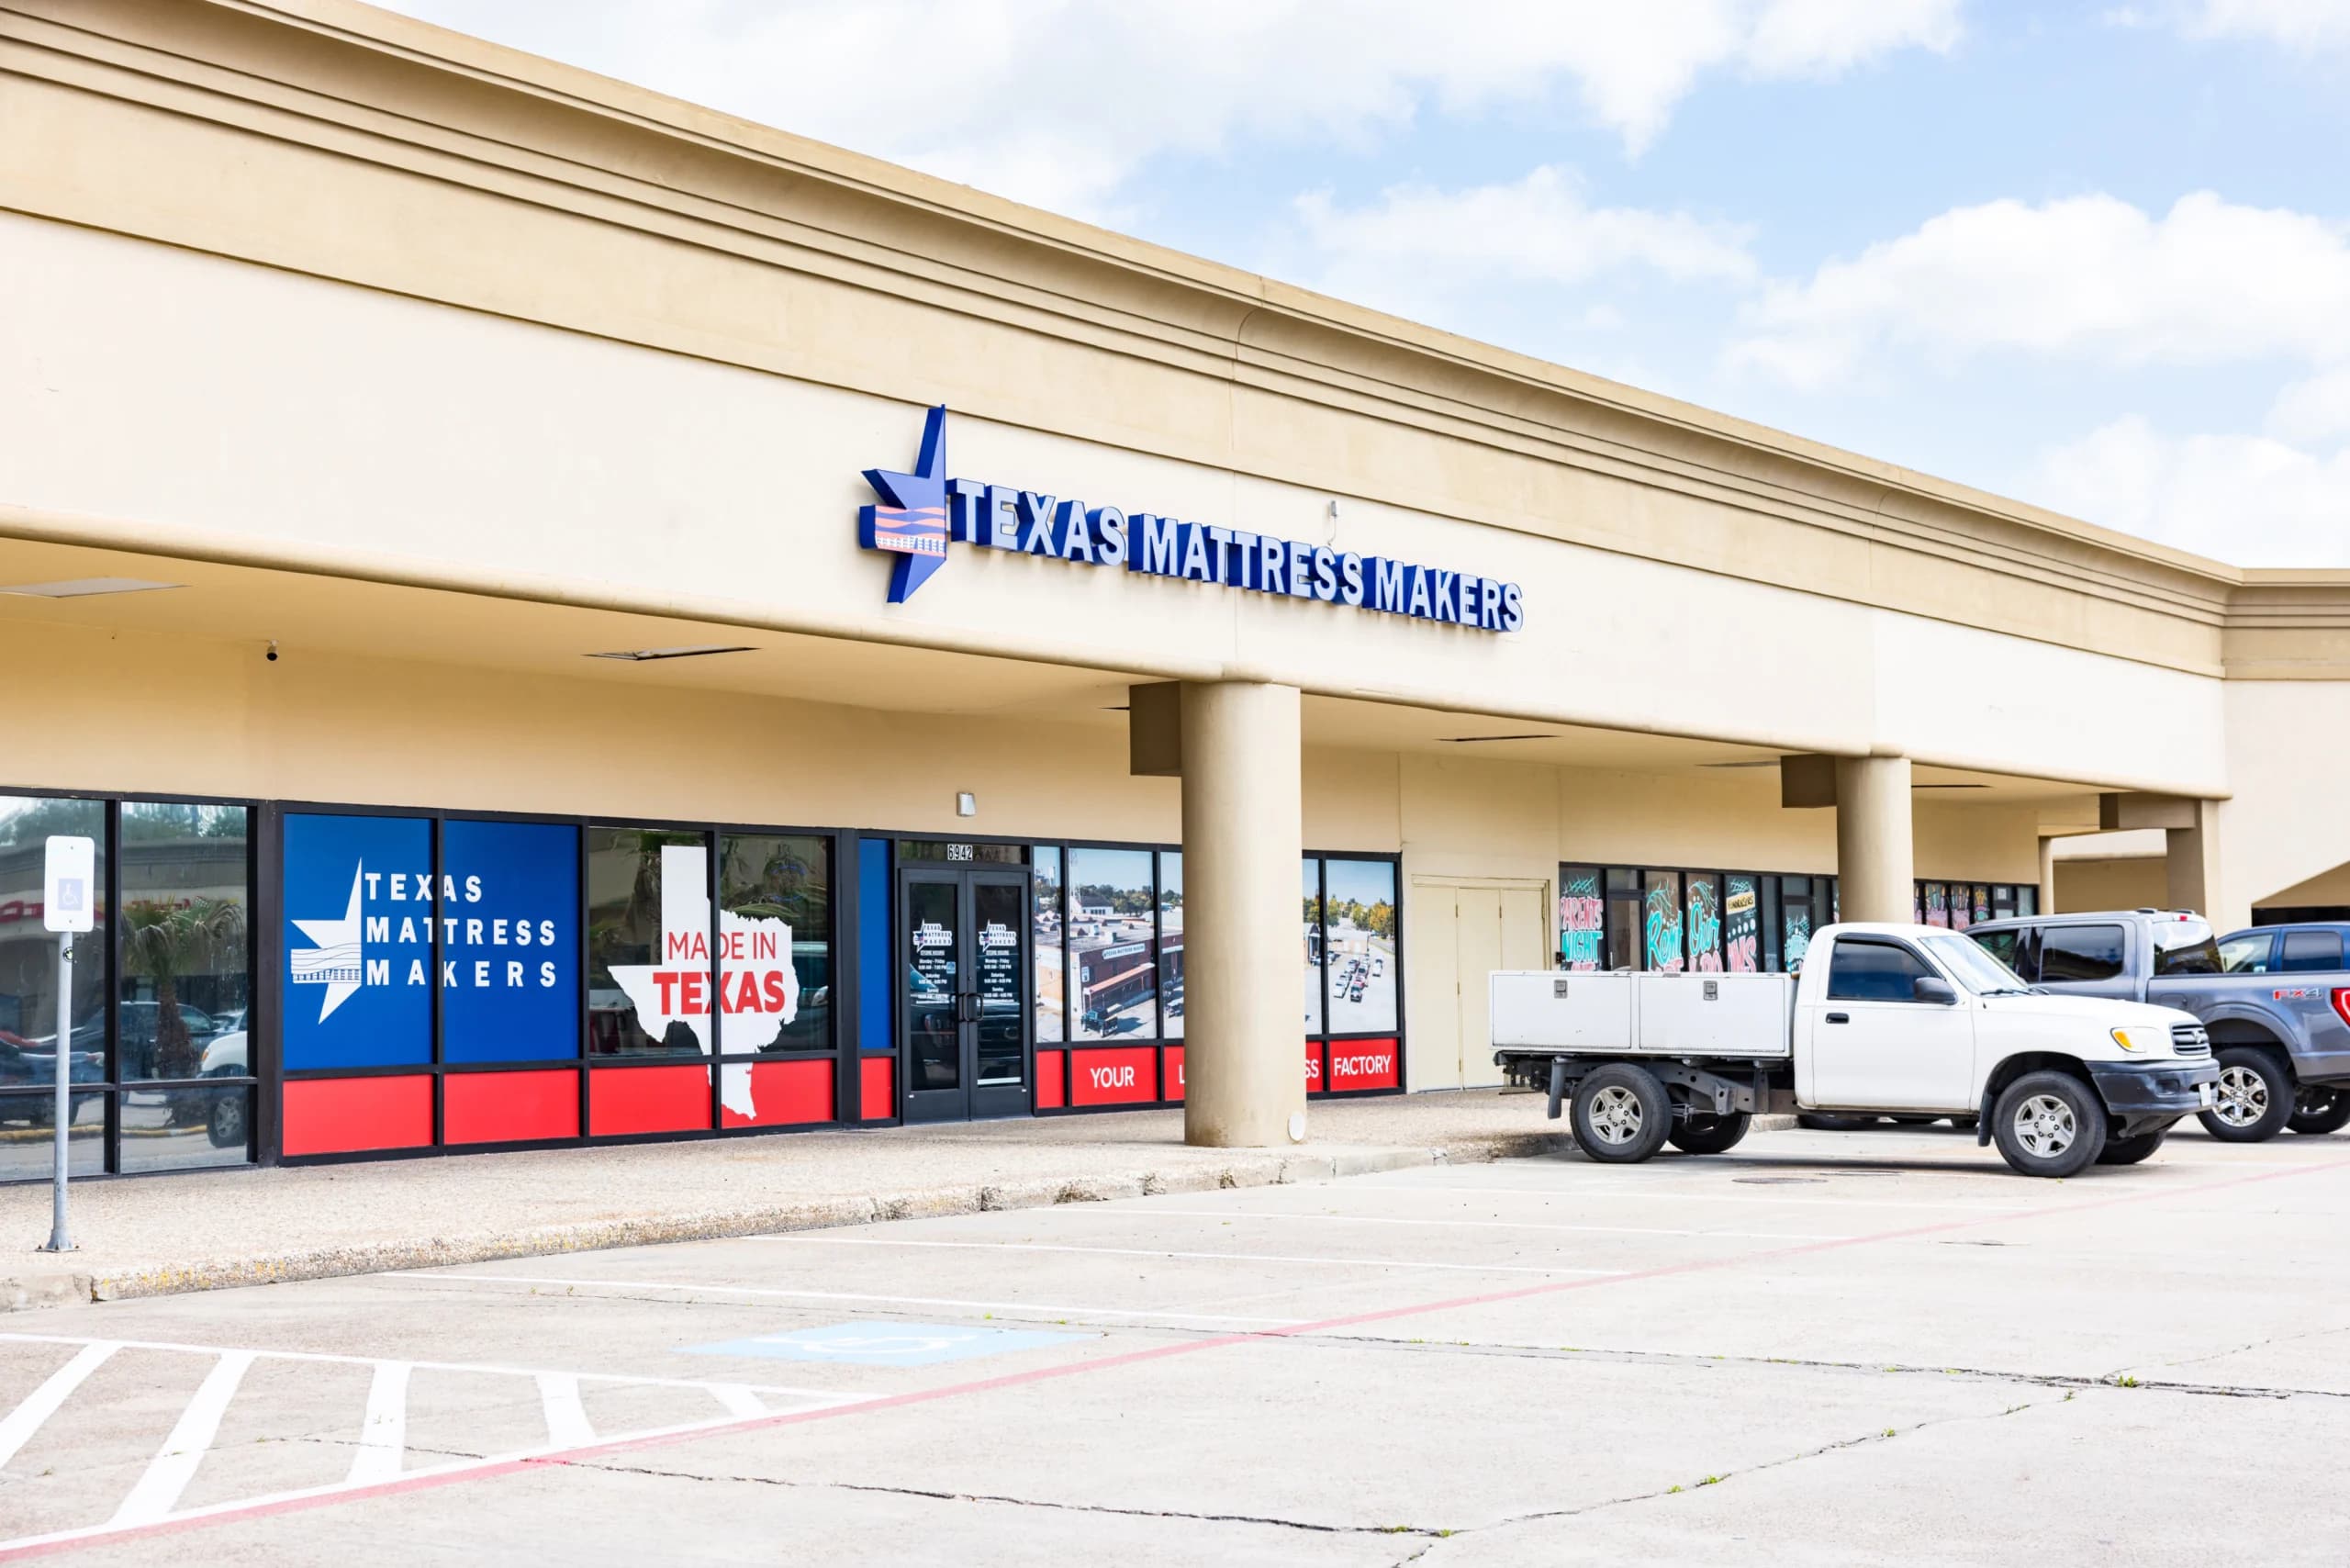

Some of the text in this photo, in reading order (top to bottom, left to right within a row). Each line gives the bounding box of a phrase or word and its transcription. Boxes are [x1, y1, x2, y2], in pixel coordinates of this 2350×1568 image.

[948, 478, 1523, 633] TEXAS MATTRESS MAKERS
[948, 845, 972, 859] 6942
[365, 873, 482, 902] TEXAS
[1560, 896, 1604, 931] PARENTS
[366, 916, 555, 946] MATTRESS
[753, 932, 776, 959] IN
[1647, 910, 1684, 970] Rent
[1689, 902, 1720, 956] Our
[1562, 931, 1604, 964] NIGHT
[366, 958, 556, 988] MAKERS
[653, 970, 785, 1015] TEXAS
[2274, 989, 2322, 1000] FX4
[1090, 1066, 1135, 1089] YOUR
[1334, 1054, 1392, 1078] FACTORY
